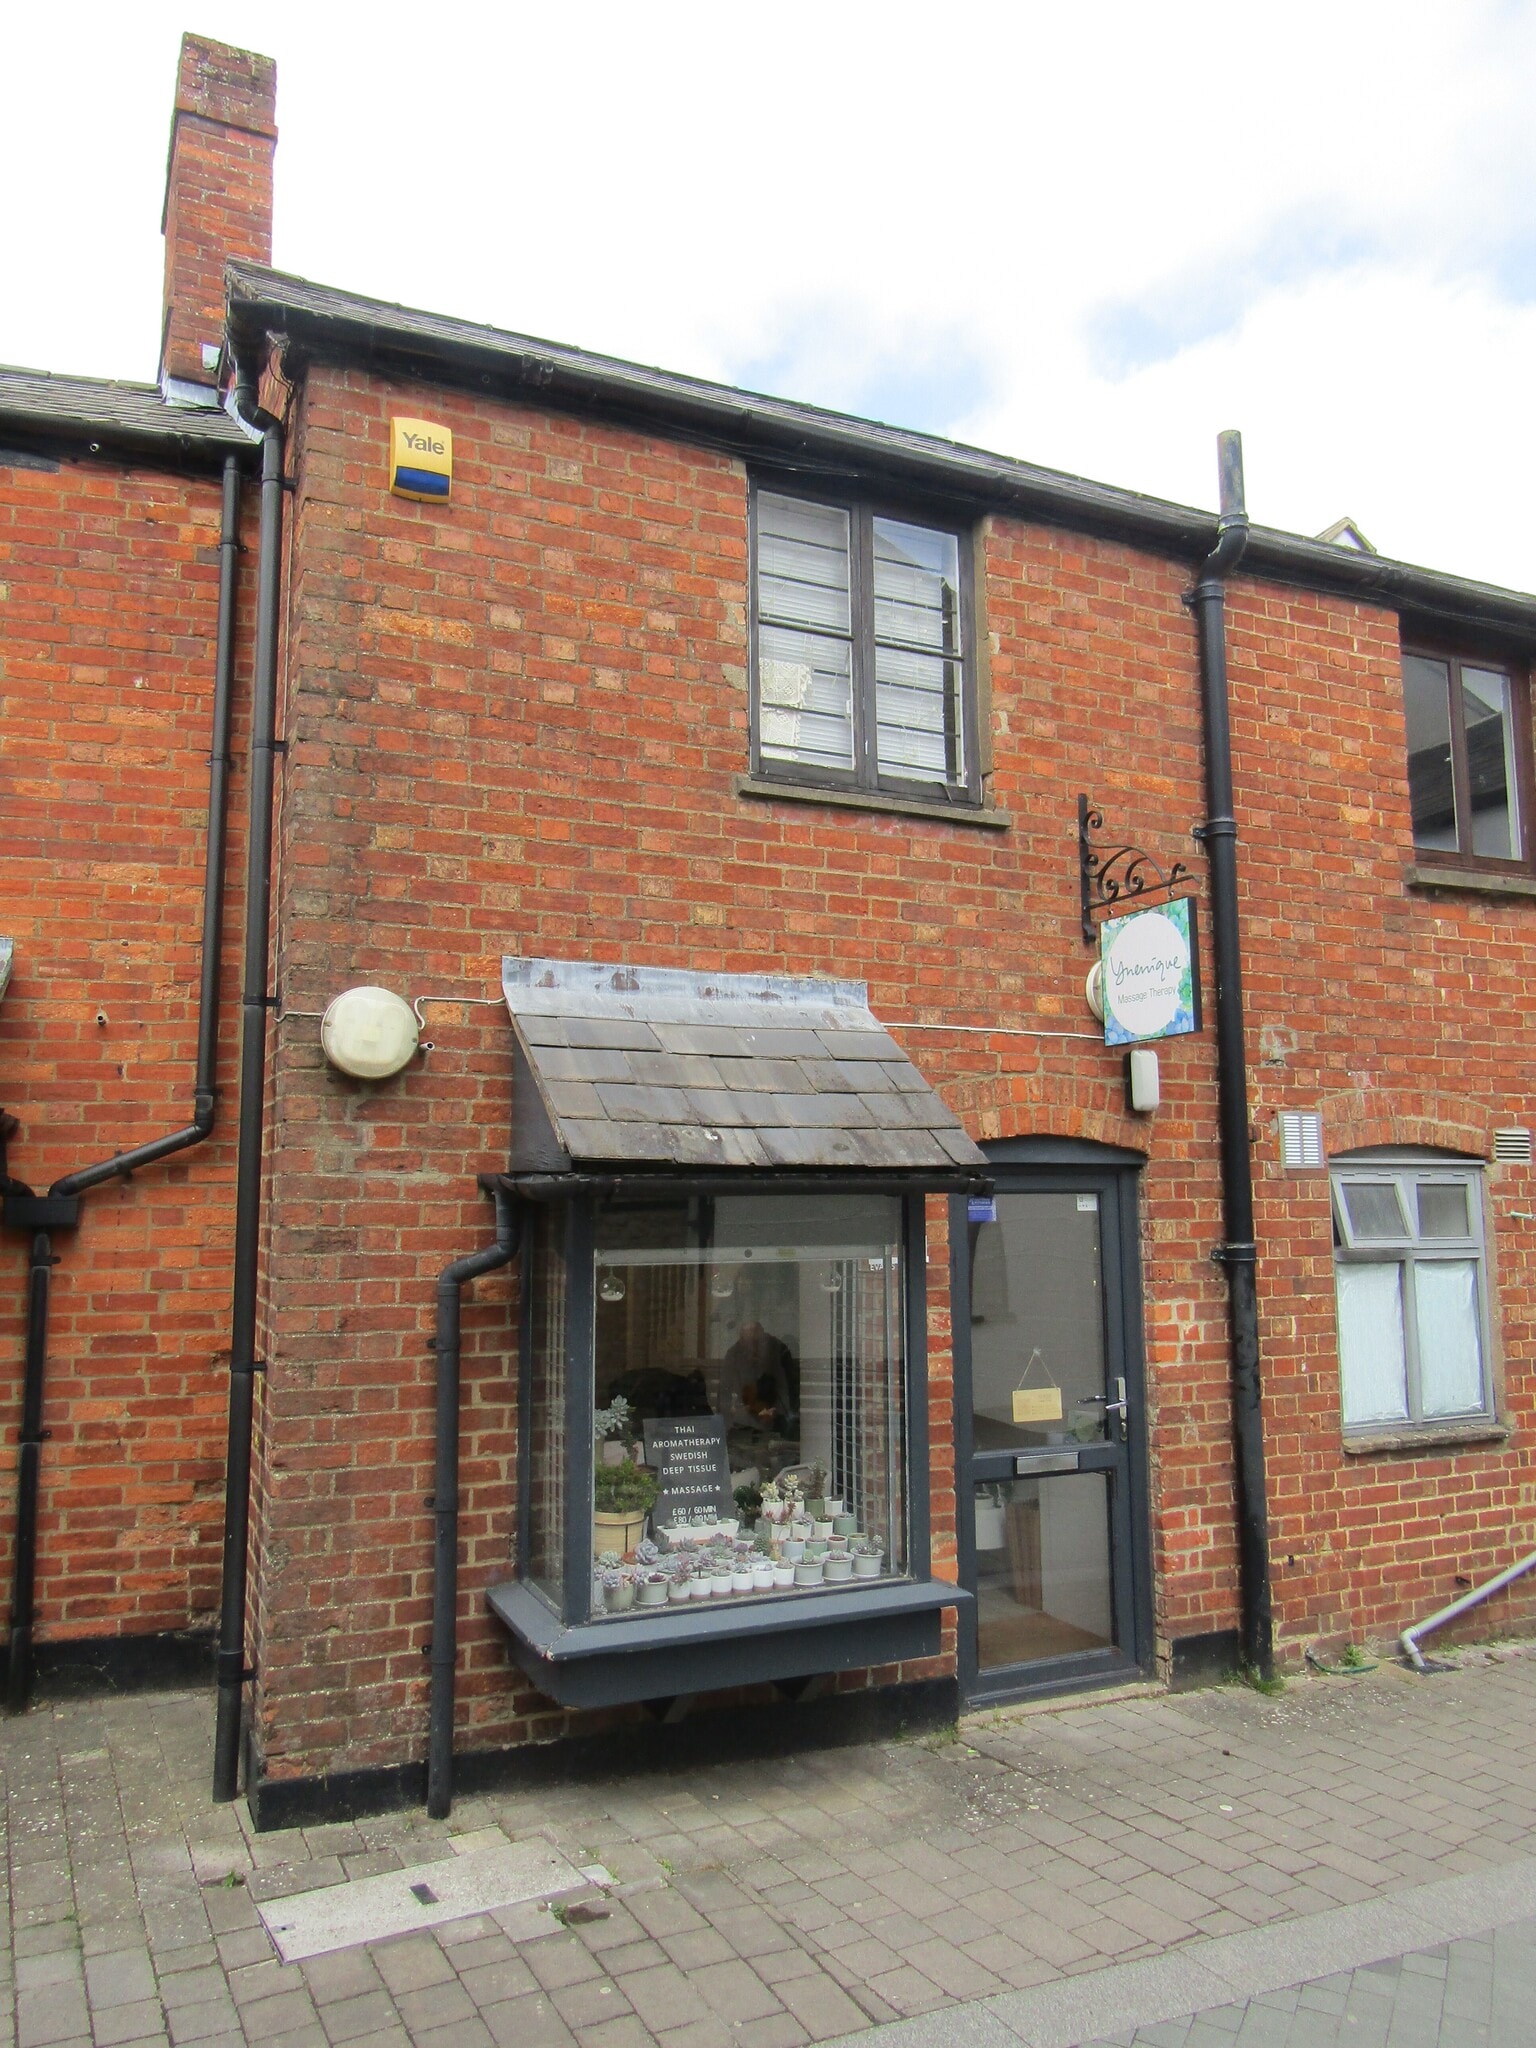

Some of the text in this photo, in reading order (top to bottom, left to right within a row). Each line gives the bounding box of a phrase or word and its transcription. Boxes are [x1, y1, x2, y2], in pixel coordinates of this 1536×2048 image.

[403, 432, 445, 455] Yale
[1117, 986, 1176, 1004] Massage Therapy
[674, 1426, 695, 1434] THAI
[652, 1437, 721, 1448] AROMATHERAPY
[670, 1451, 708, 1460] SWEDISH
[662, 1464, 717, 1475] DEEP TISSUE
[671, 1484, 713, 1494] MASSAGE
